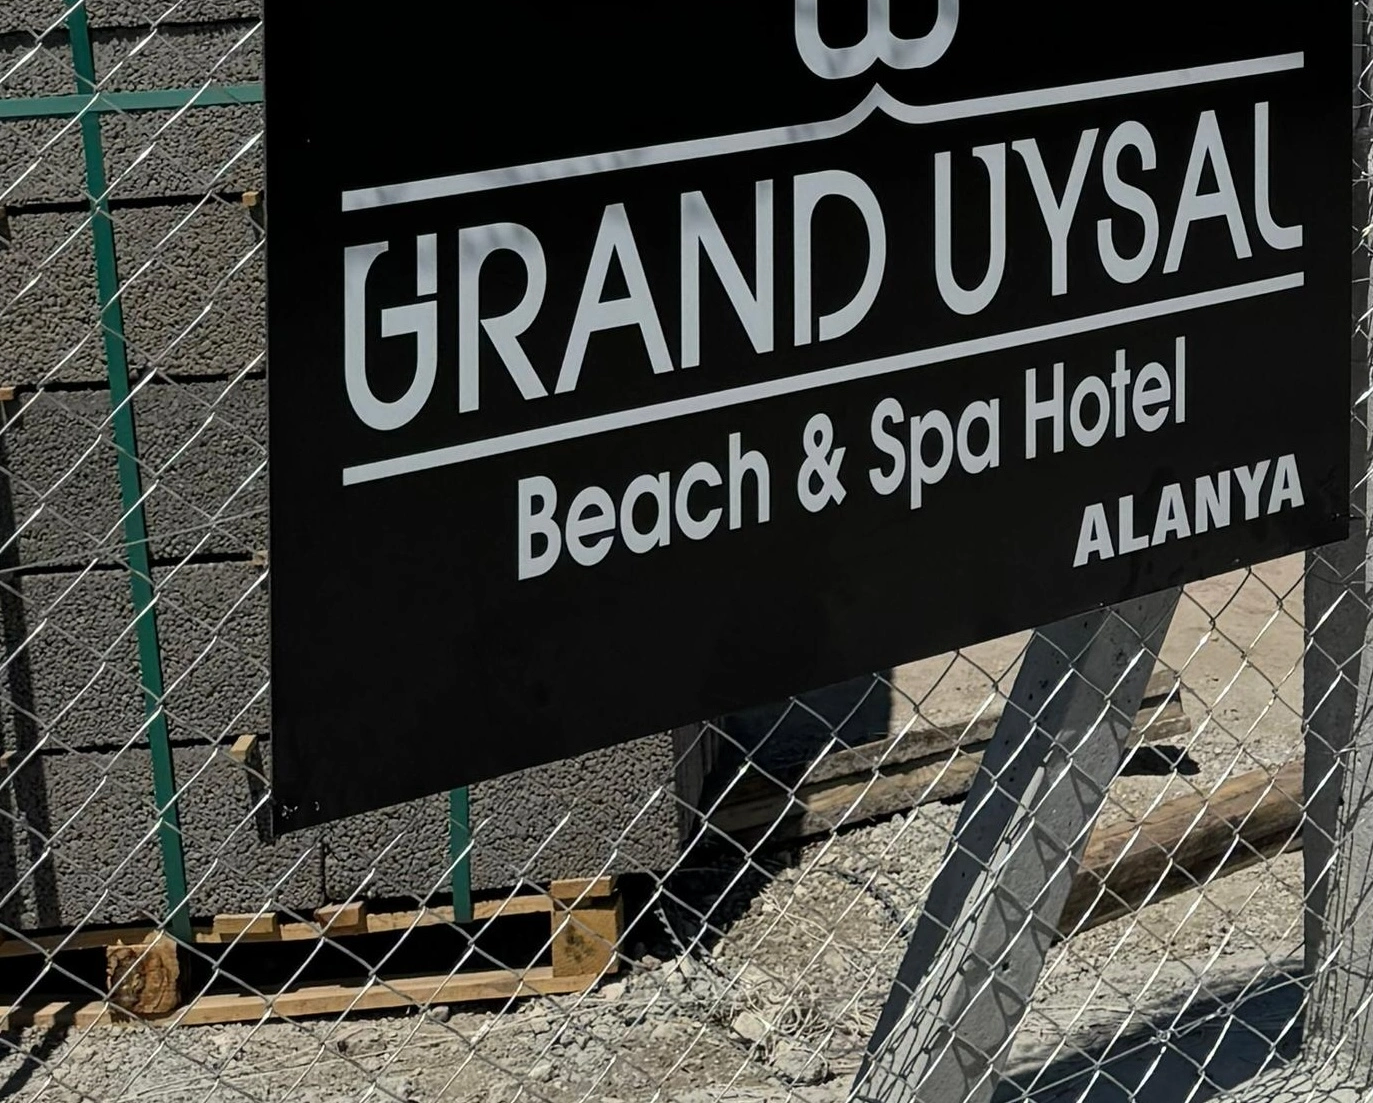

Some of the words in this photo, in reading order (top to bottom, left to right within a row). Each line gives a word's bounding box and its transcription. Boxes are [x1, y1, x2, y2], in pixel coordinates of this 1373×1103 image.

[344, 170, 886, 430] GRAND
[935, 101, 1304, 315] UYSAL
[518, 432, 770, 580] Beach
[797, 413, 846, 512] &
[869, 398, 999, 509] Spa
[1026, 336, 1185, 459] Hotel
[1073, 454, 1304, 567] ALANYA
